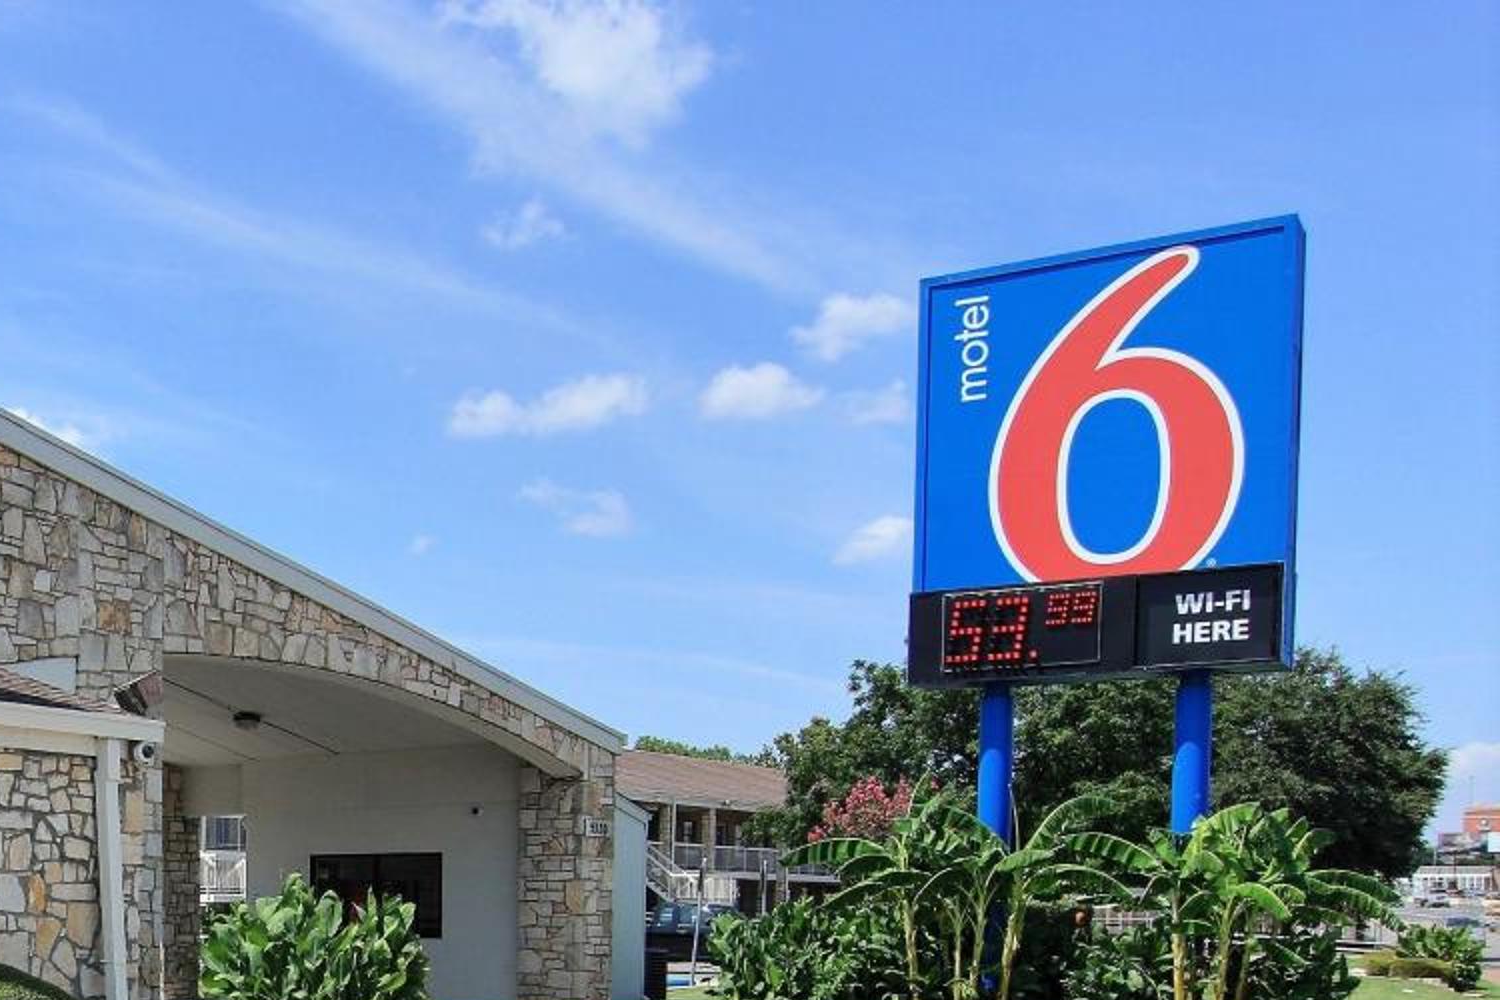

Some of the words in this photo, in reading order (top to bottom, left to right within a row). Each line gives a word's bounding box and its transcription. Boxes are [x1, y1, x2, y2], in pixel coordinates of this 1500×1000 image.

[955, 295, 989, 403] motel
[989, 245, 1245, 583] 6
[1175, 589, 1251, 615] WI-FI
[1172, 618, 1250, 644] HERE
